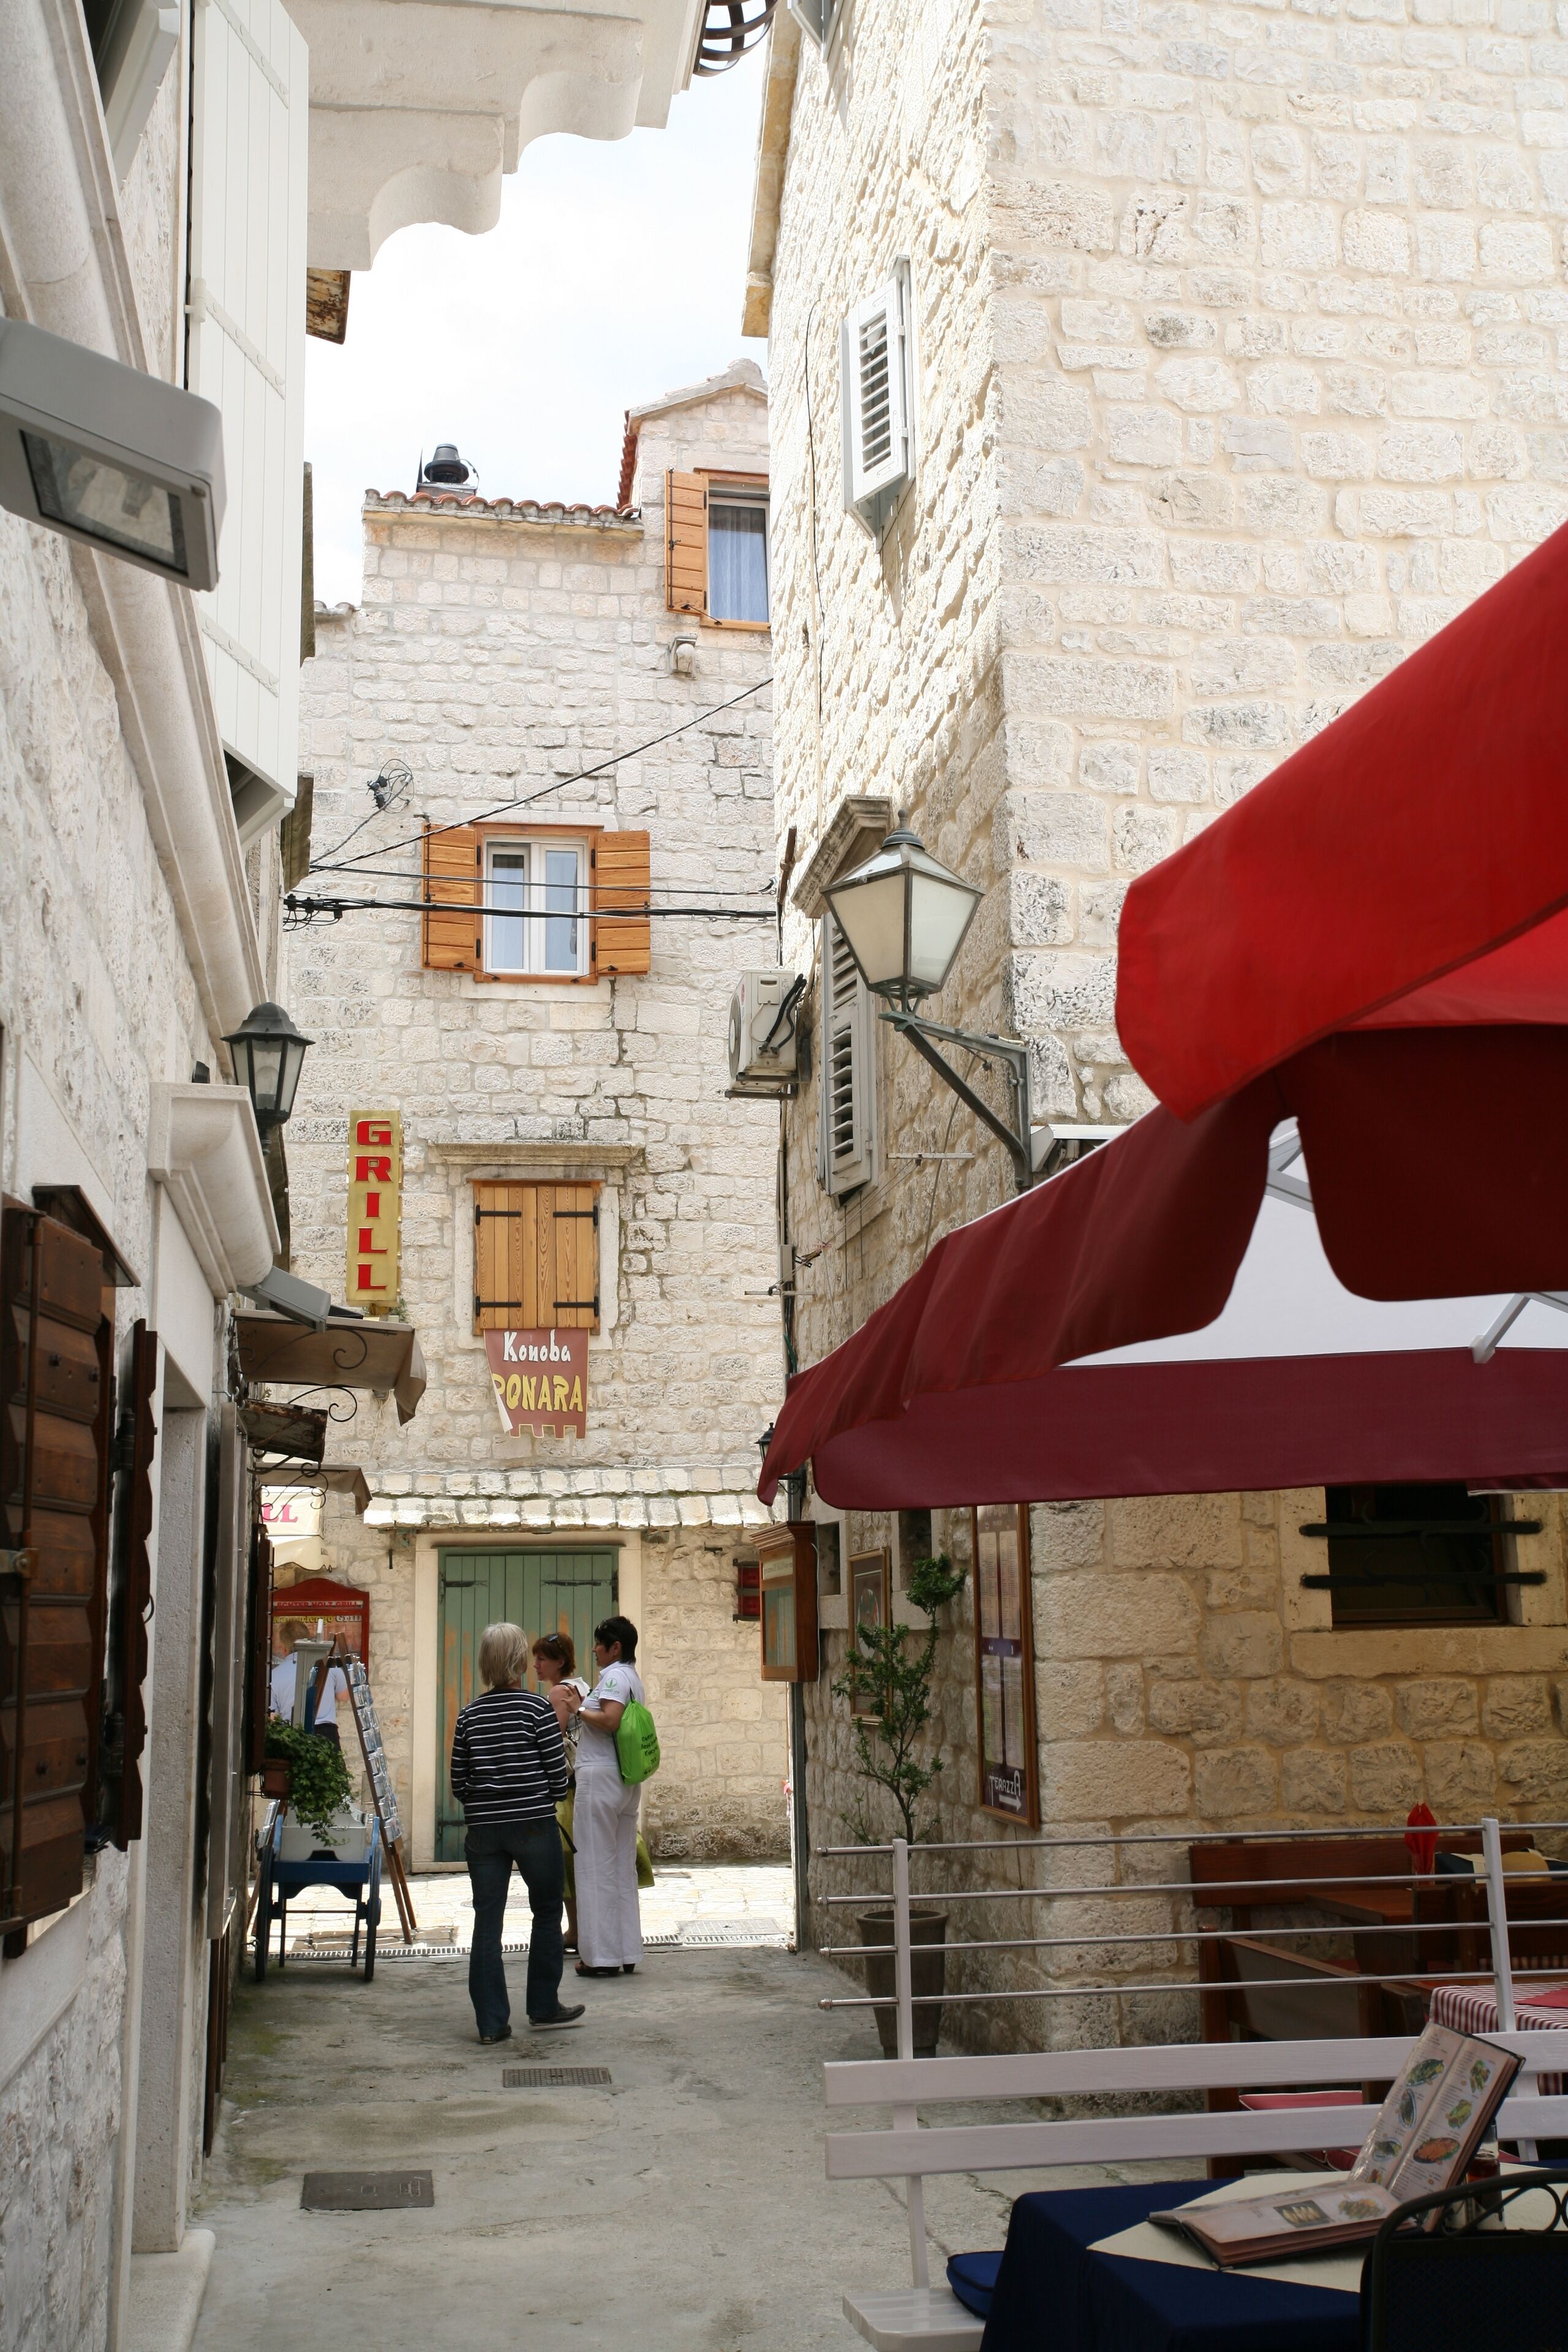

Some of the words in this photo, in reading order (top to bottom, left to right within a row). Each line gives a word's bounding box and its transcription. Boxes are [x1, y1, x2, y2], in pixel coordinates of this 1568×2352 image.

[354, 1119, 393, 1291] GRILL
[503, 1329, 571, 1362] Konoba
[989, 1770, 1020, 1806] TERAZZA
